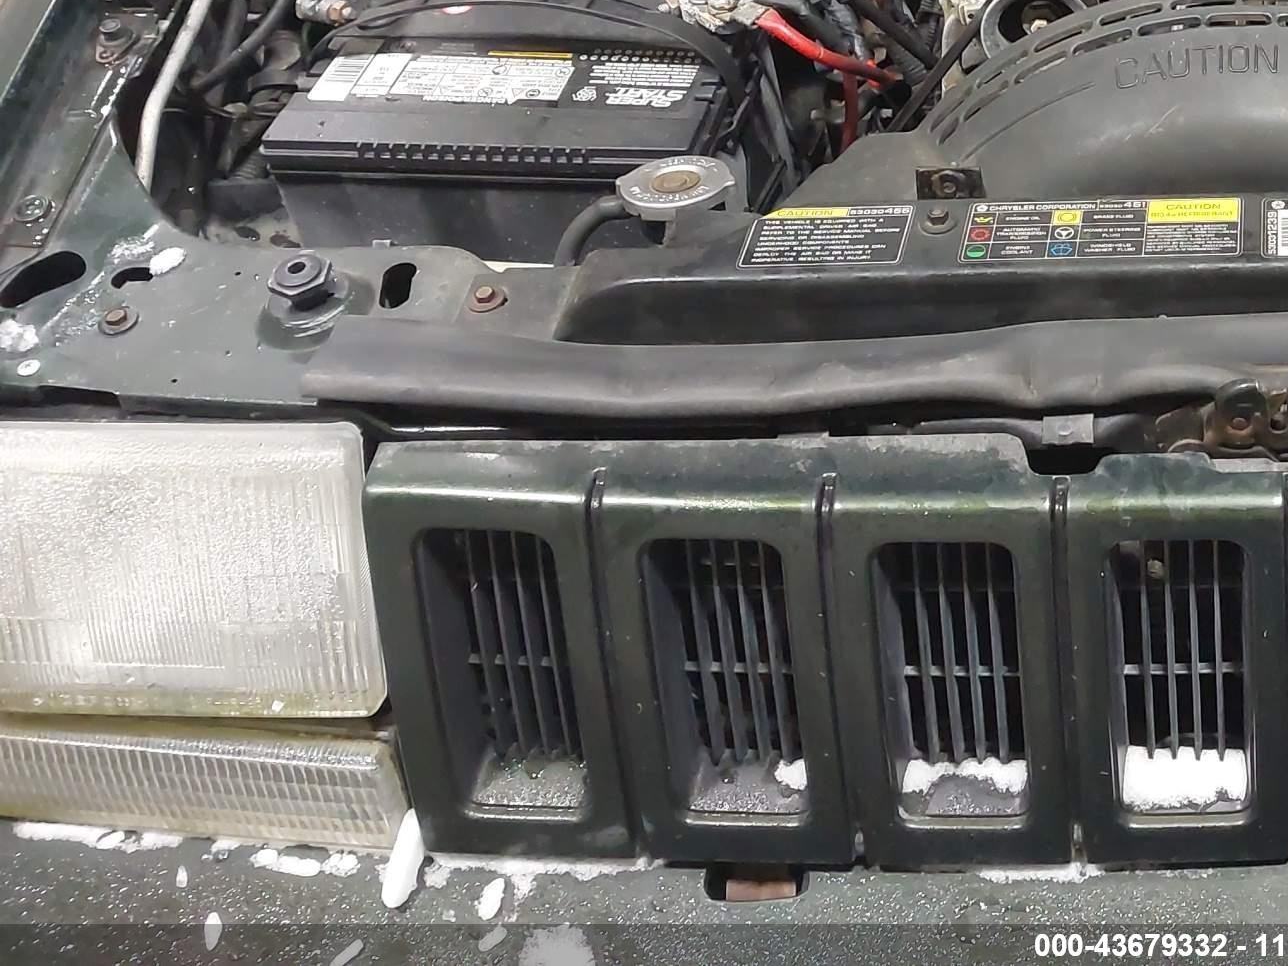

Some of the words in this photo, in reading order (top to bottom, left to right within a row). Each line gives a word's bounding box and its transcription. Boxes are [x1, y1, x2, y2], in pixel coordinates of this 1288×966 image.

[1115, 44, 1281, 91] CAUTION
[605, 87, 688, 102] START
[605, 96, 673, 108] SUPER
[1036, 203, 1096, 211] CORPORATION
[1166, 203, 1221, 211] CAUTION
